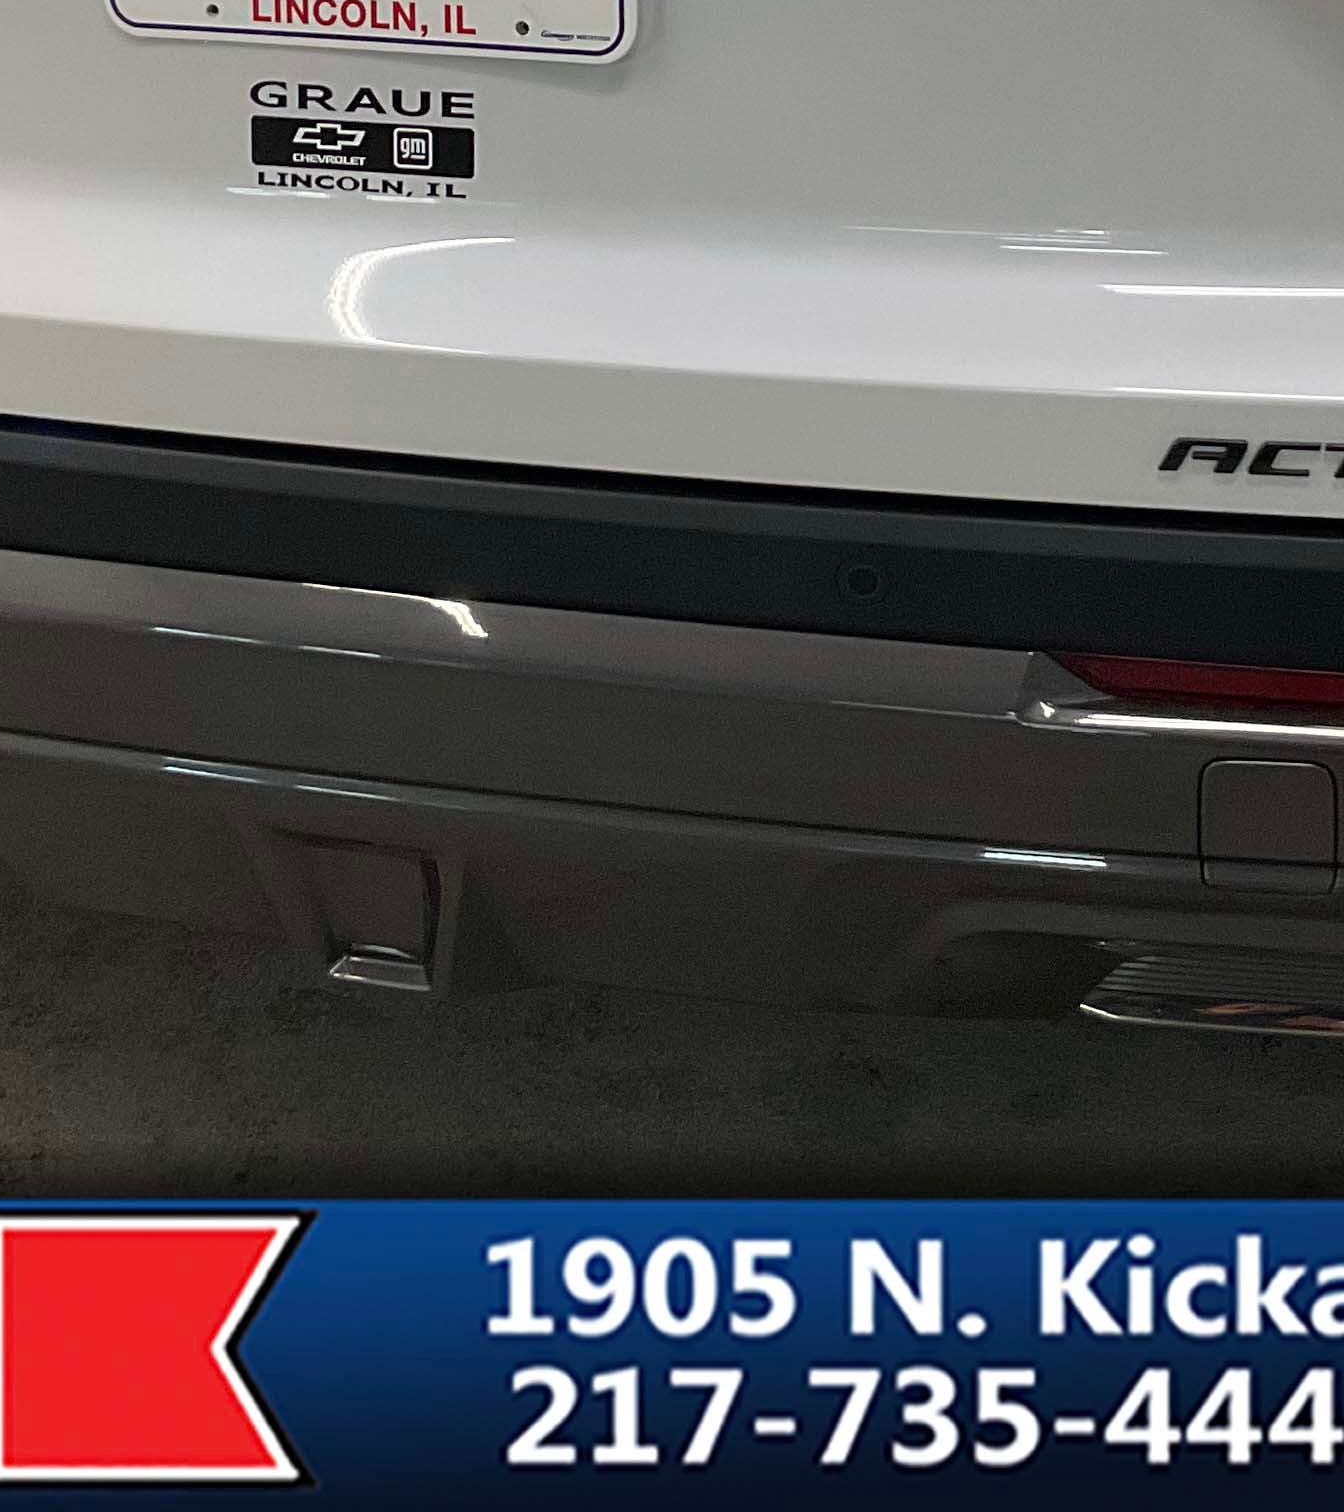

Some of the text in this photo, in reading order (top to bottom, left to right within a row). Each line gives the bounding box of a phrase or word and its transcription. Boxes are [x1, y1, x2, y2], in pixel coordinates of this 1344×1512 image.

[443, 4, 477, 35] IL
[250, 80, 475, 120] GRAUE
[292, 152, 367, 167] CHEVROLET
[400, 137, 427, 160] gm
[258, 171, 467, 199] LINCOLN, IL
